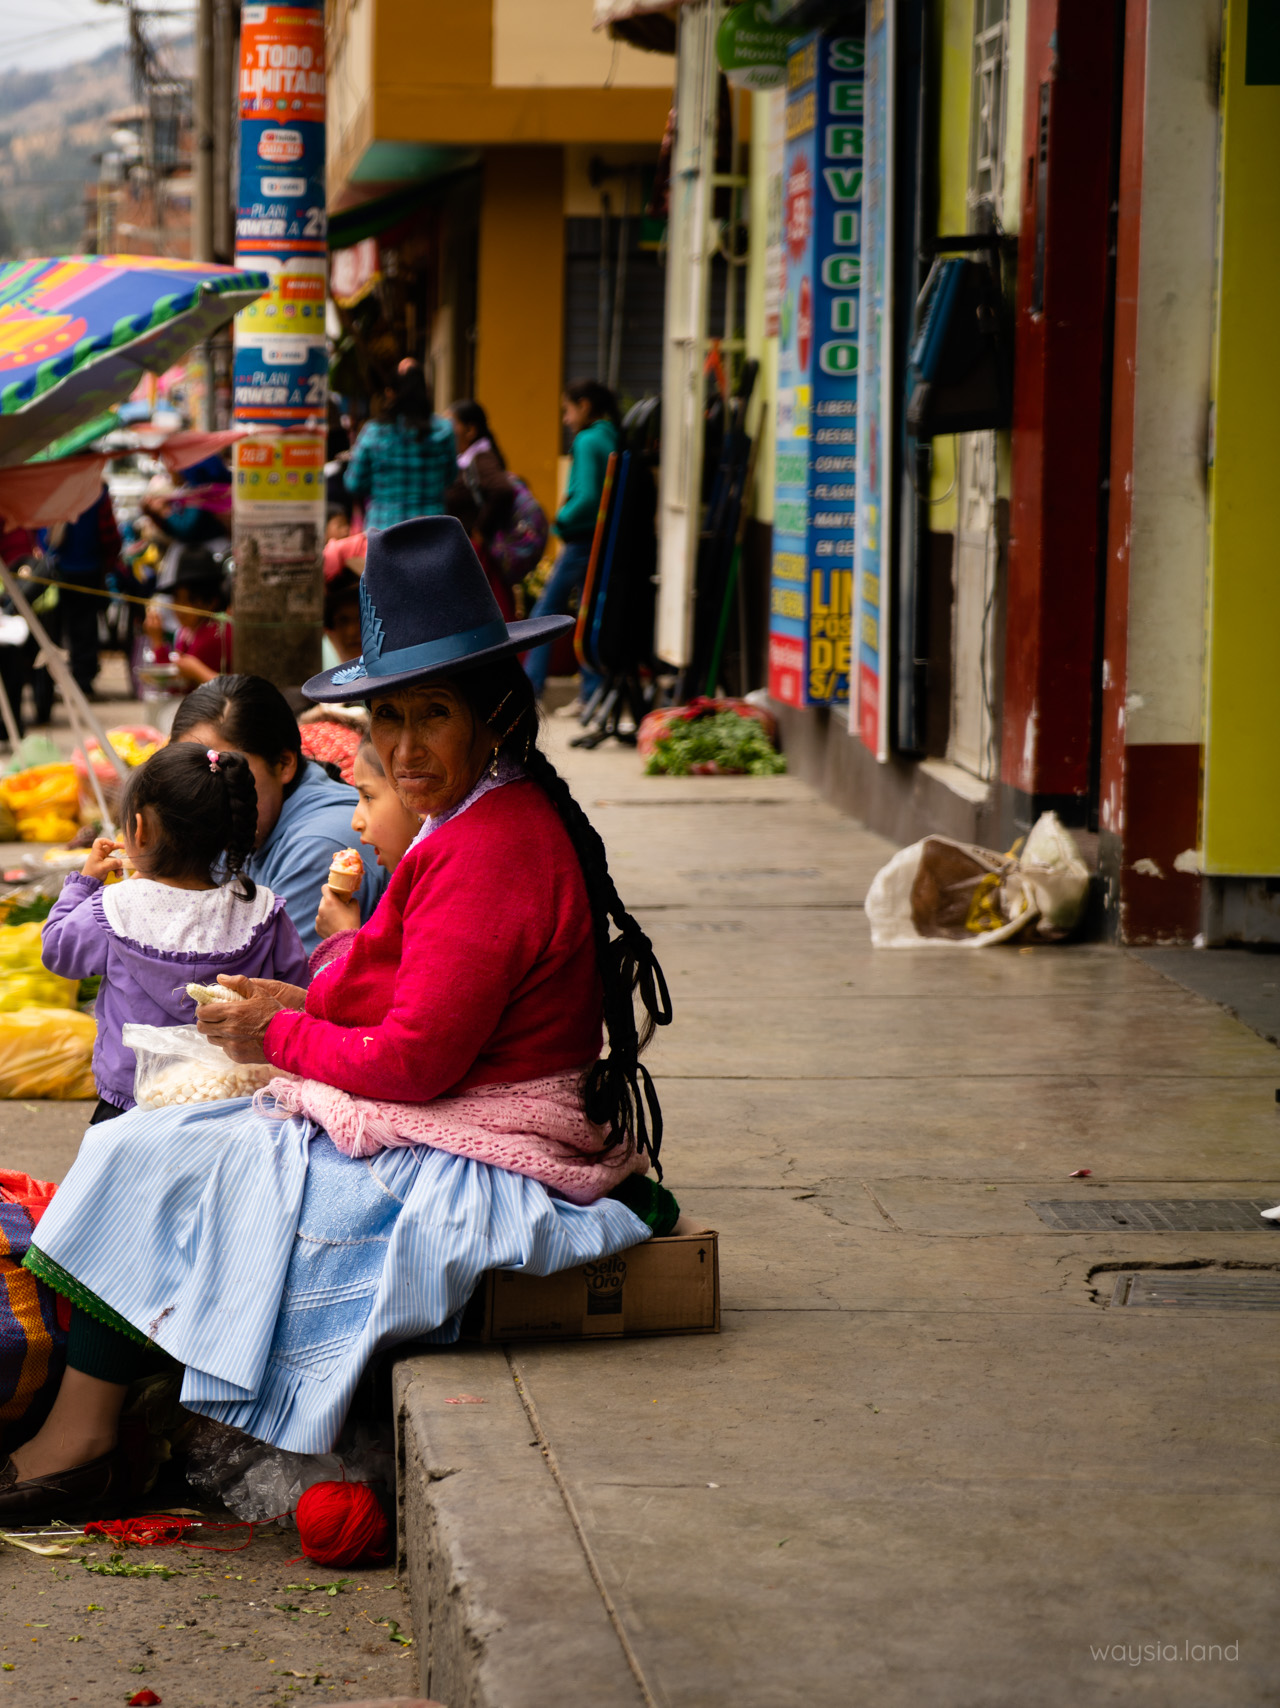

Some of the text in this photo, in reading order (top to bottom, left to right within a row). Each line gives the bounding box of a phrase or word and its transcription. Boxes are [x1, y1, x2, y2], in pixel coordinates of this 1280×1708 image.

[256, 44, 313, 69] TODO
[251, 203, 288, 217] PLAN
[819, 38, 865, 376] SERVICIO
[252, 371, 290, 385] PLAN
[583, 1259, 626, 1276] Sello
[593, 1275, 619, 1289] Oro
